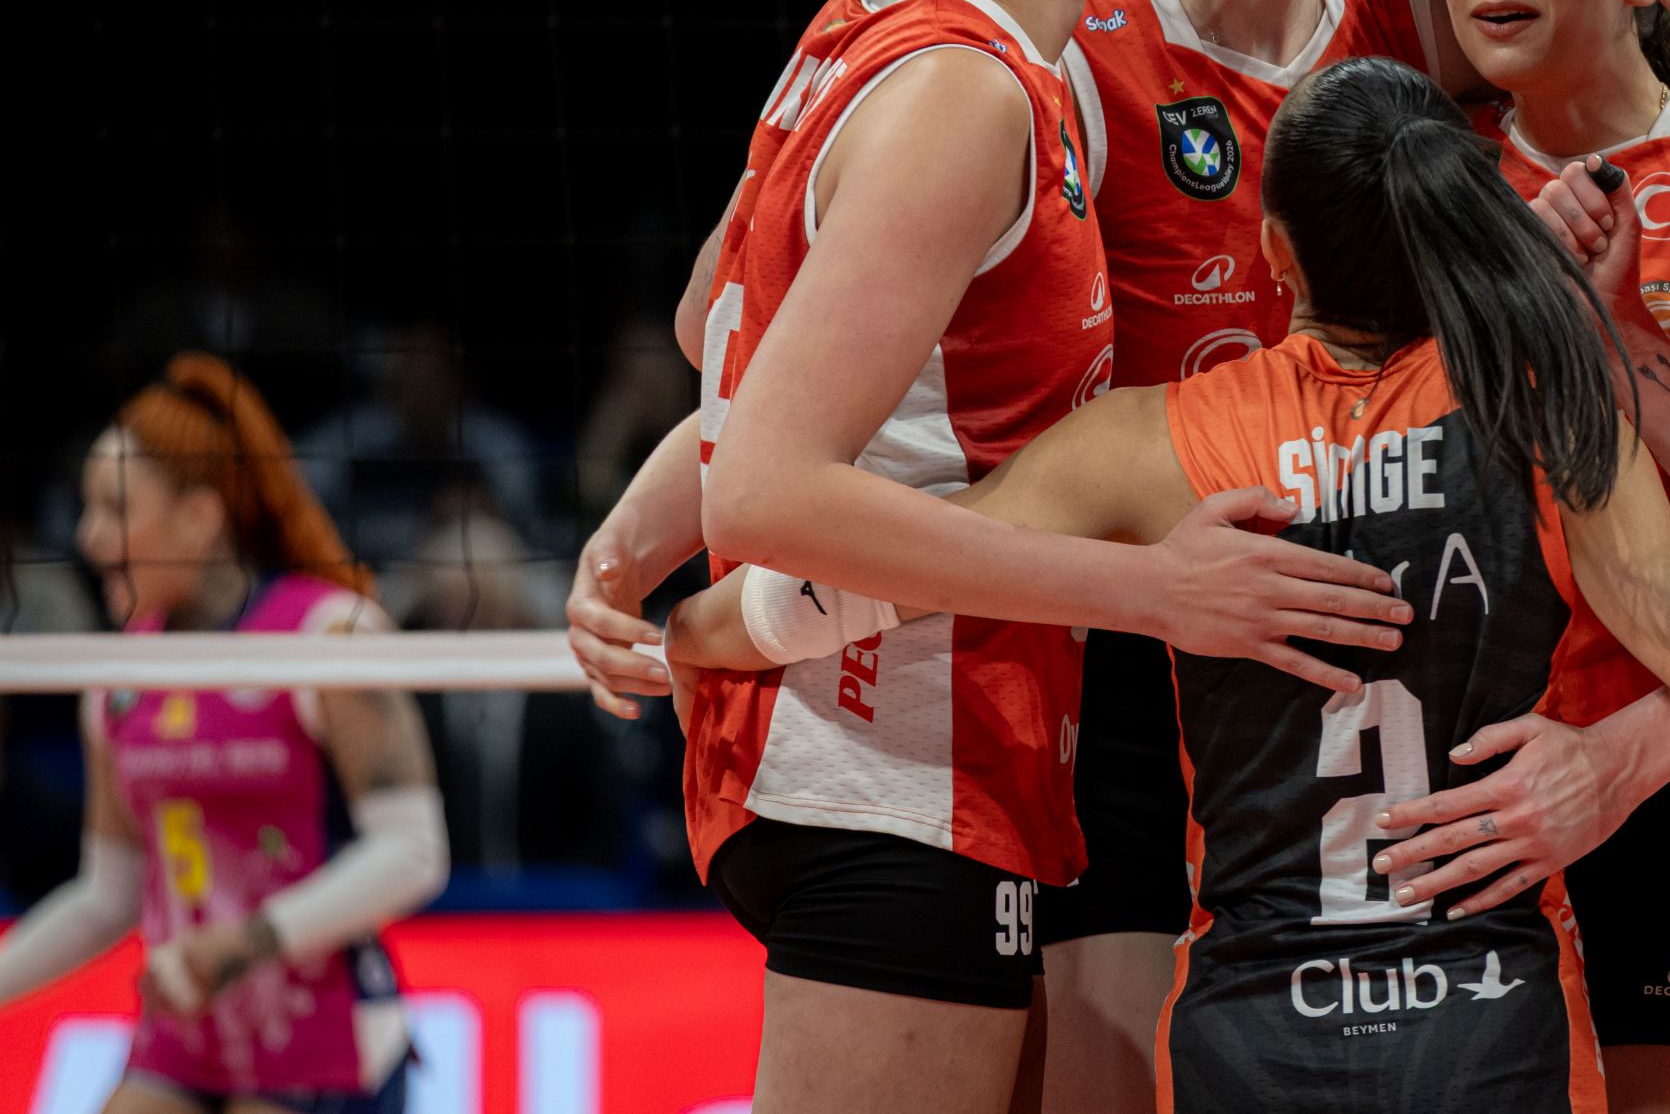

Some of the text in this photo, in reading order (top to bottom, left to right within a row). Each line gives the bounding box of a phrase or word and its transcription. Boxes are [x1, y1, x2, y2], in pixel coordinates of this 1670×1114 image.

[1169, 143, 1197, 187] Champions
[1226, 140, 1234, 163] 2026
[1174, 290, 1256, 306] DECATHLON
[1311, 678, 1434, 926] 2
[995, 881, 1033, 956] 99
[1290, 957, 1449, 1018] Club
[1343, 1022, 1397, 1037] BEYMEN
